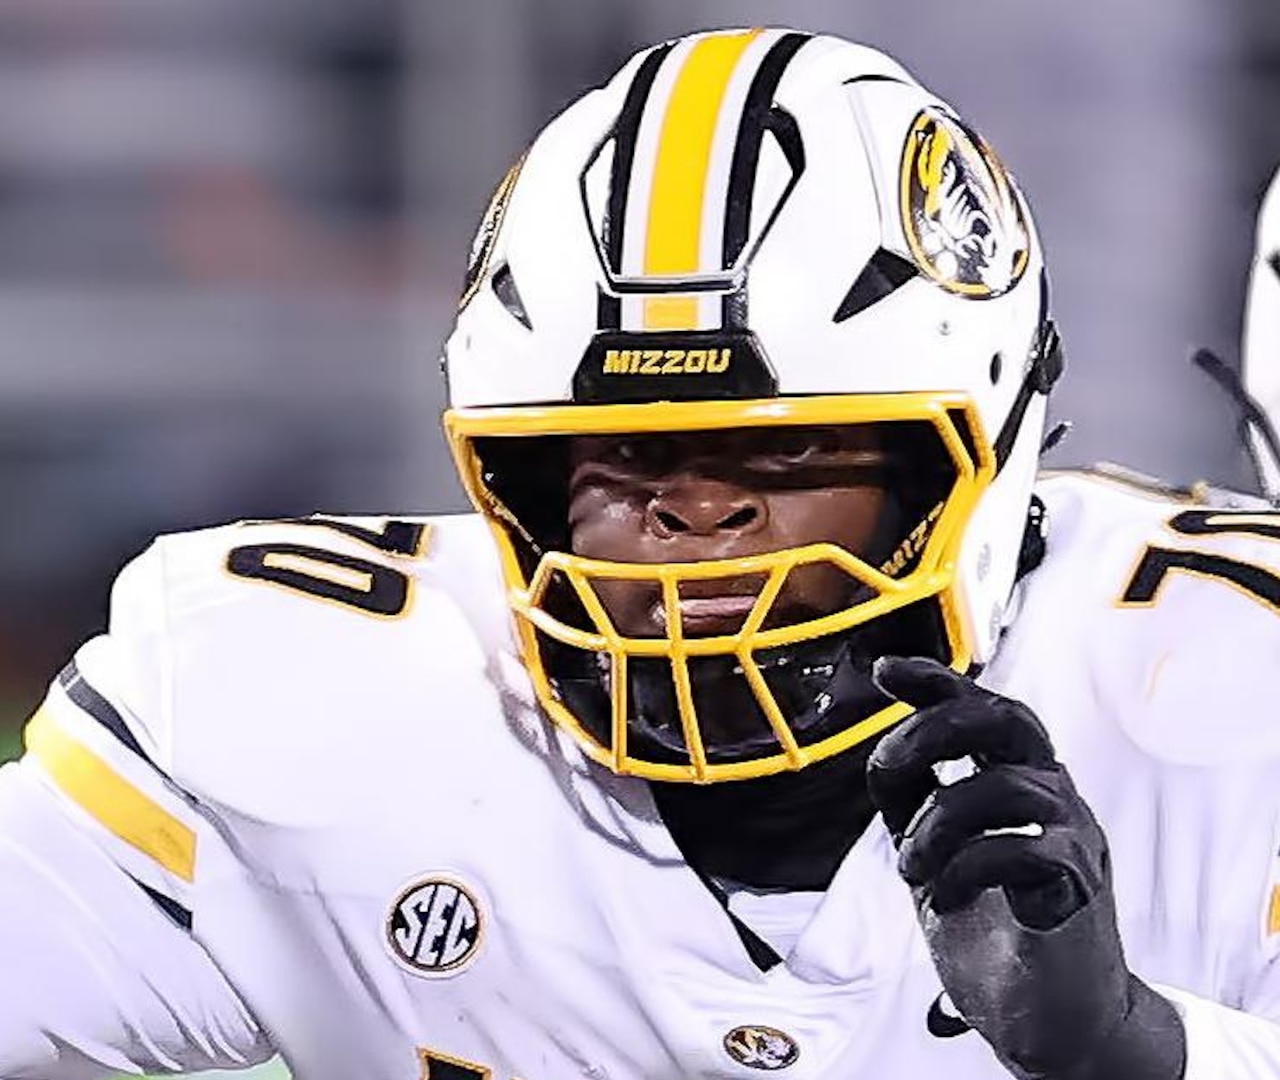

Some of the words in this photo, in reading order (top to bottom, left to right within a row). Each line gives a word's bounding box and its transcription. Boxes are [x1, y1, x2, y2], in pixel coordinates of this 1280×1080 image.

[602, 348, 732, 375] MIZZOU
[880, 500, 944, 575] MIZ
[394, 883, 478, 966] SEC
